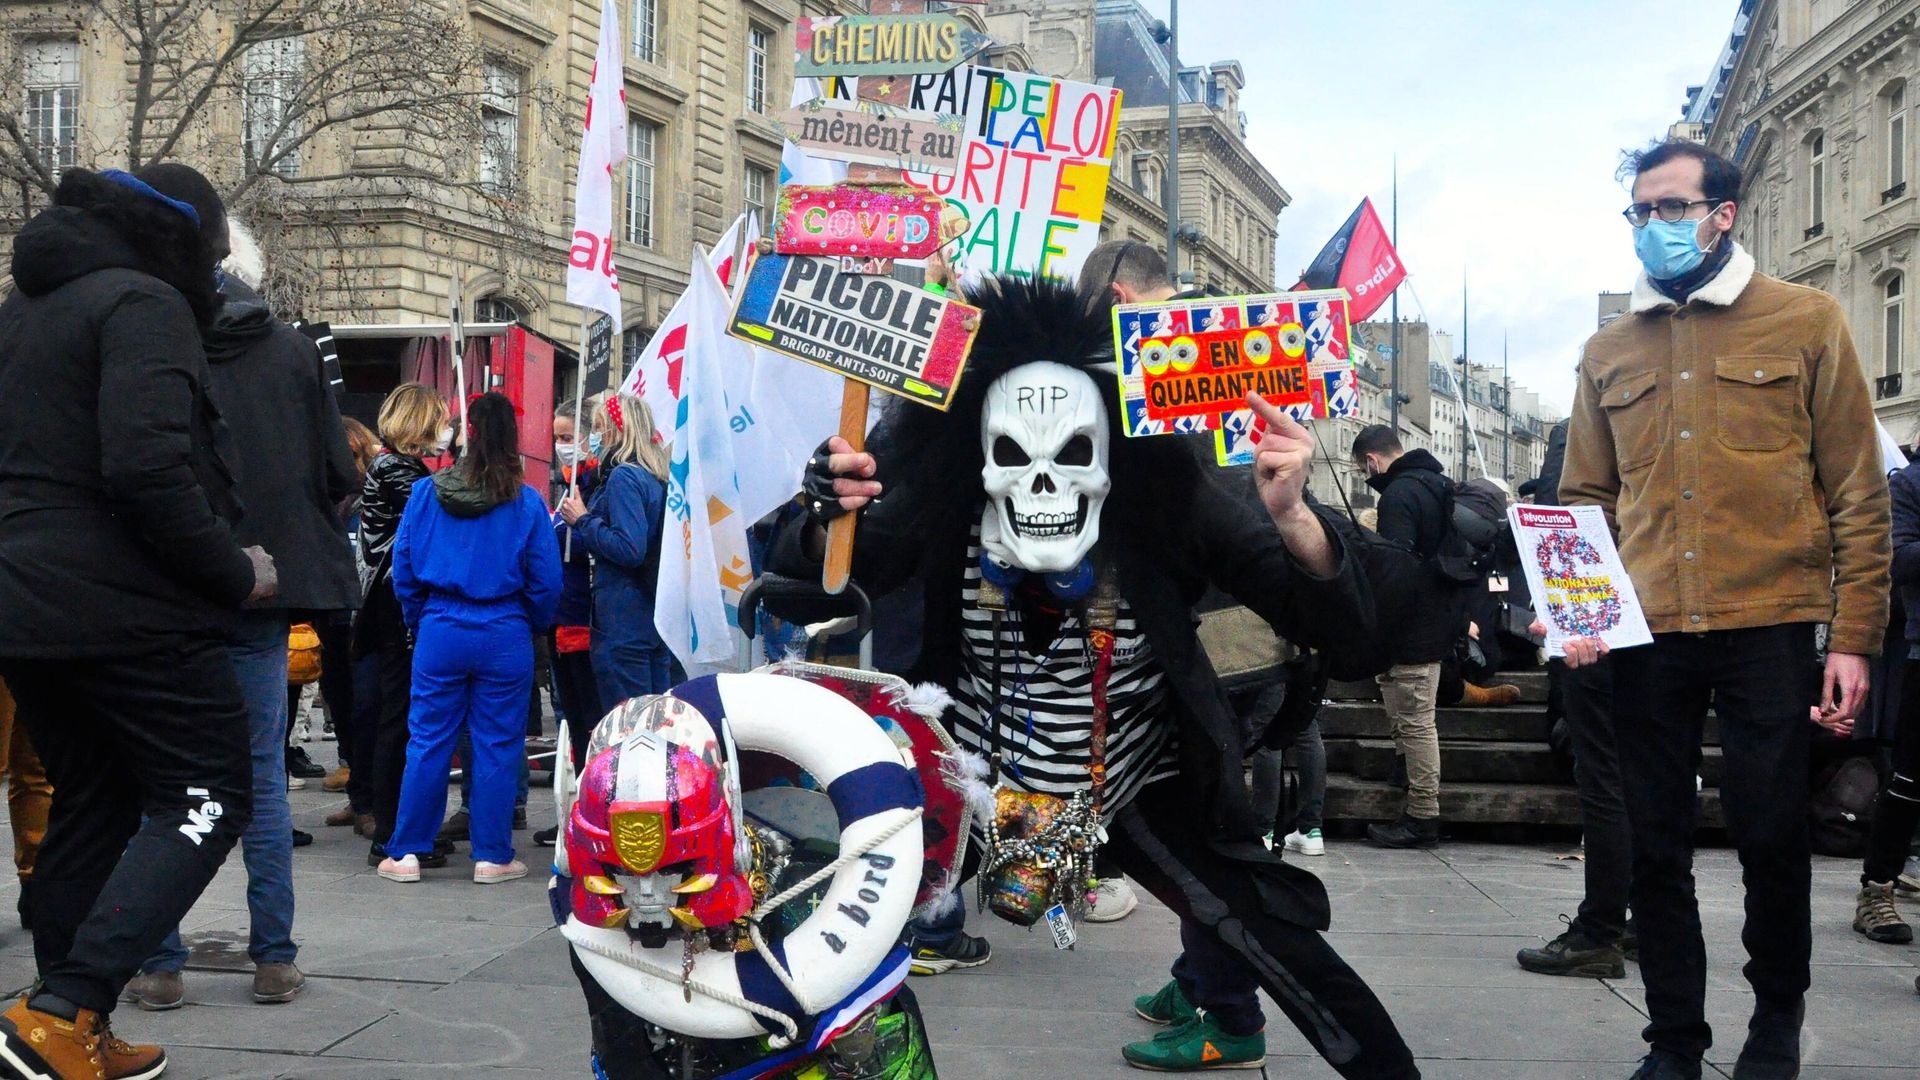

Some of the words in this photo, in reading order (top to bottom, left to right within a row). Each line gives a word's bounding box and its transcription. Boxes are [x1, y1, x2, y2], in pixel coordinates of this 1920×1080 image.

[811, 22, 959, 66] CHEMINS
[991, 77, 1052, 118] DE
[800, 111, 913, 154] mènent
[920, 132, 954, 159] au
[986, 111, 1045, 152] LA
[803, 207, 930, 244] COVID
[784, 256, 942, 339] PICOLE
[771, 299, 926, 373] NATIONALE
[1210, 340, 1239, 368] EN
[779, 335, 833, 363] BRIGADE
[834, 353, 900, 385] ANTI-SOIF
[1017, 386, 1069, 415] RIP
[1151, 367, 1306, 409] QUARANTAINE
[837, 852, 896, 928] bord
